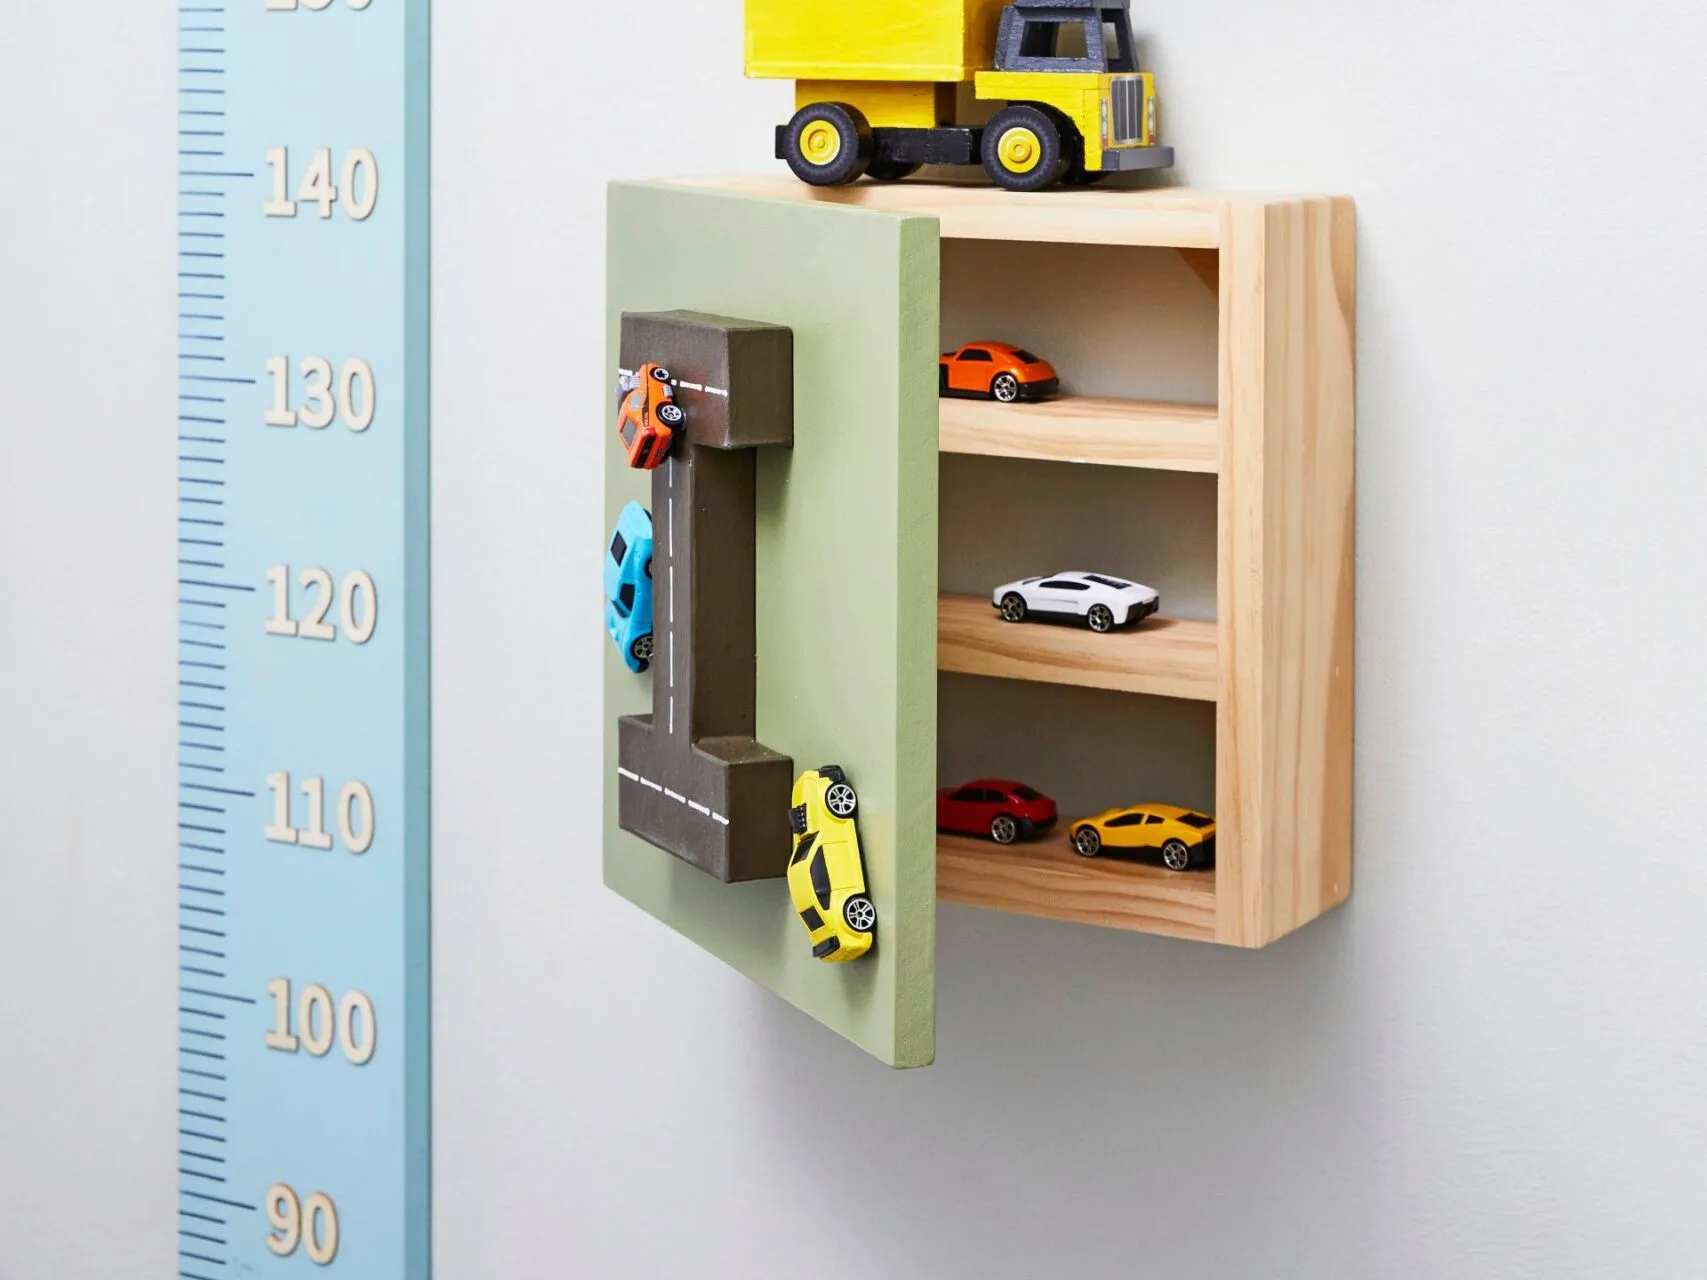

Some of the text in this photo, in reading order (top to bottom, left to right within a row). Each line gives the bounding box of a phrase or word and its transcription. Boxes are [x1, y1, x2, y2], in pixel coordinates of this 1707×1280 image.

[262, 144, 379, 221] 140
[263, 354, 376, 432] 130
[264, 564, 378, 645] 120
[264, 771, 375, 855] 110
[264, 977, 377, 1066] 100
[265, 1182, 340, 1265] 90
